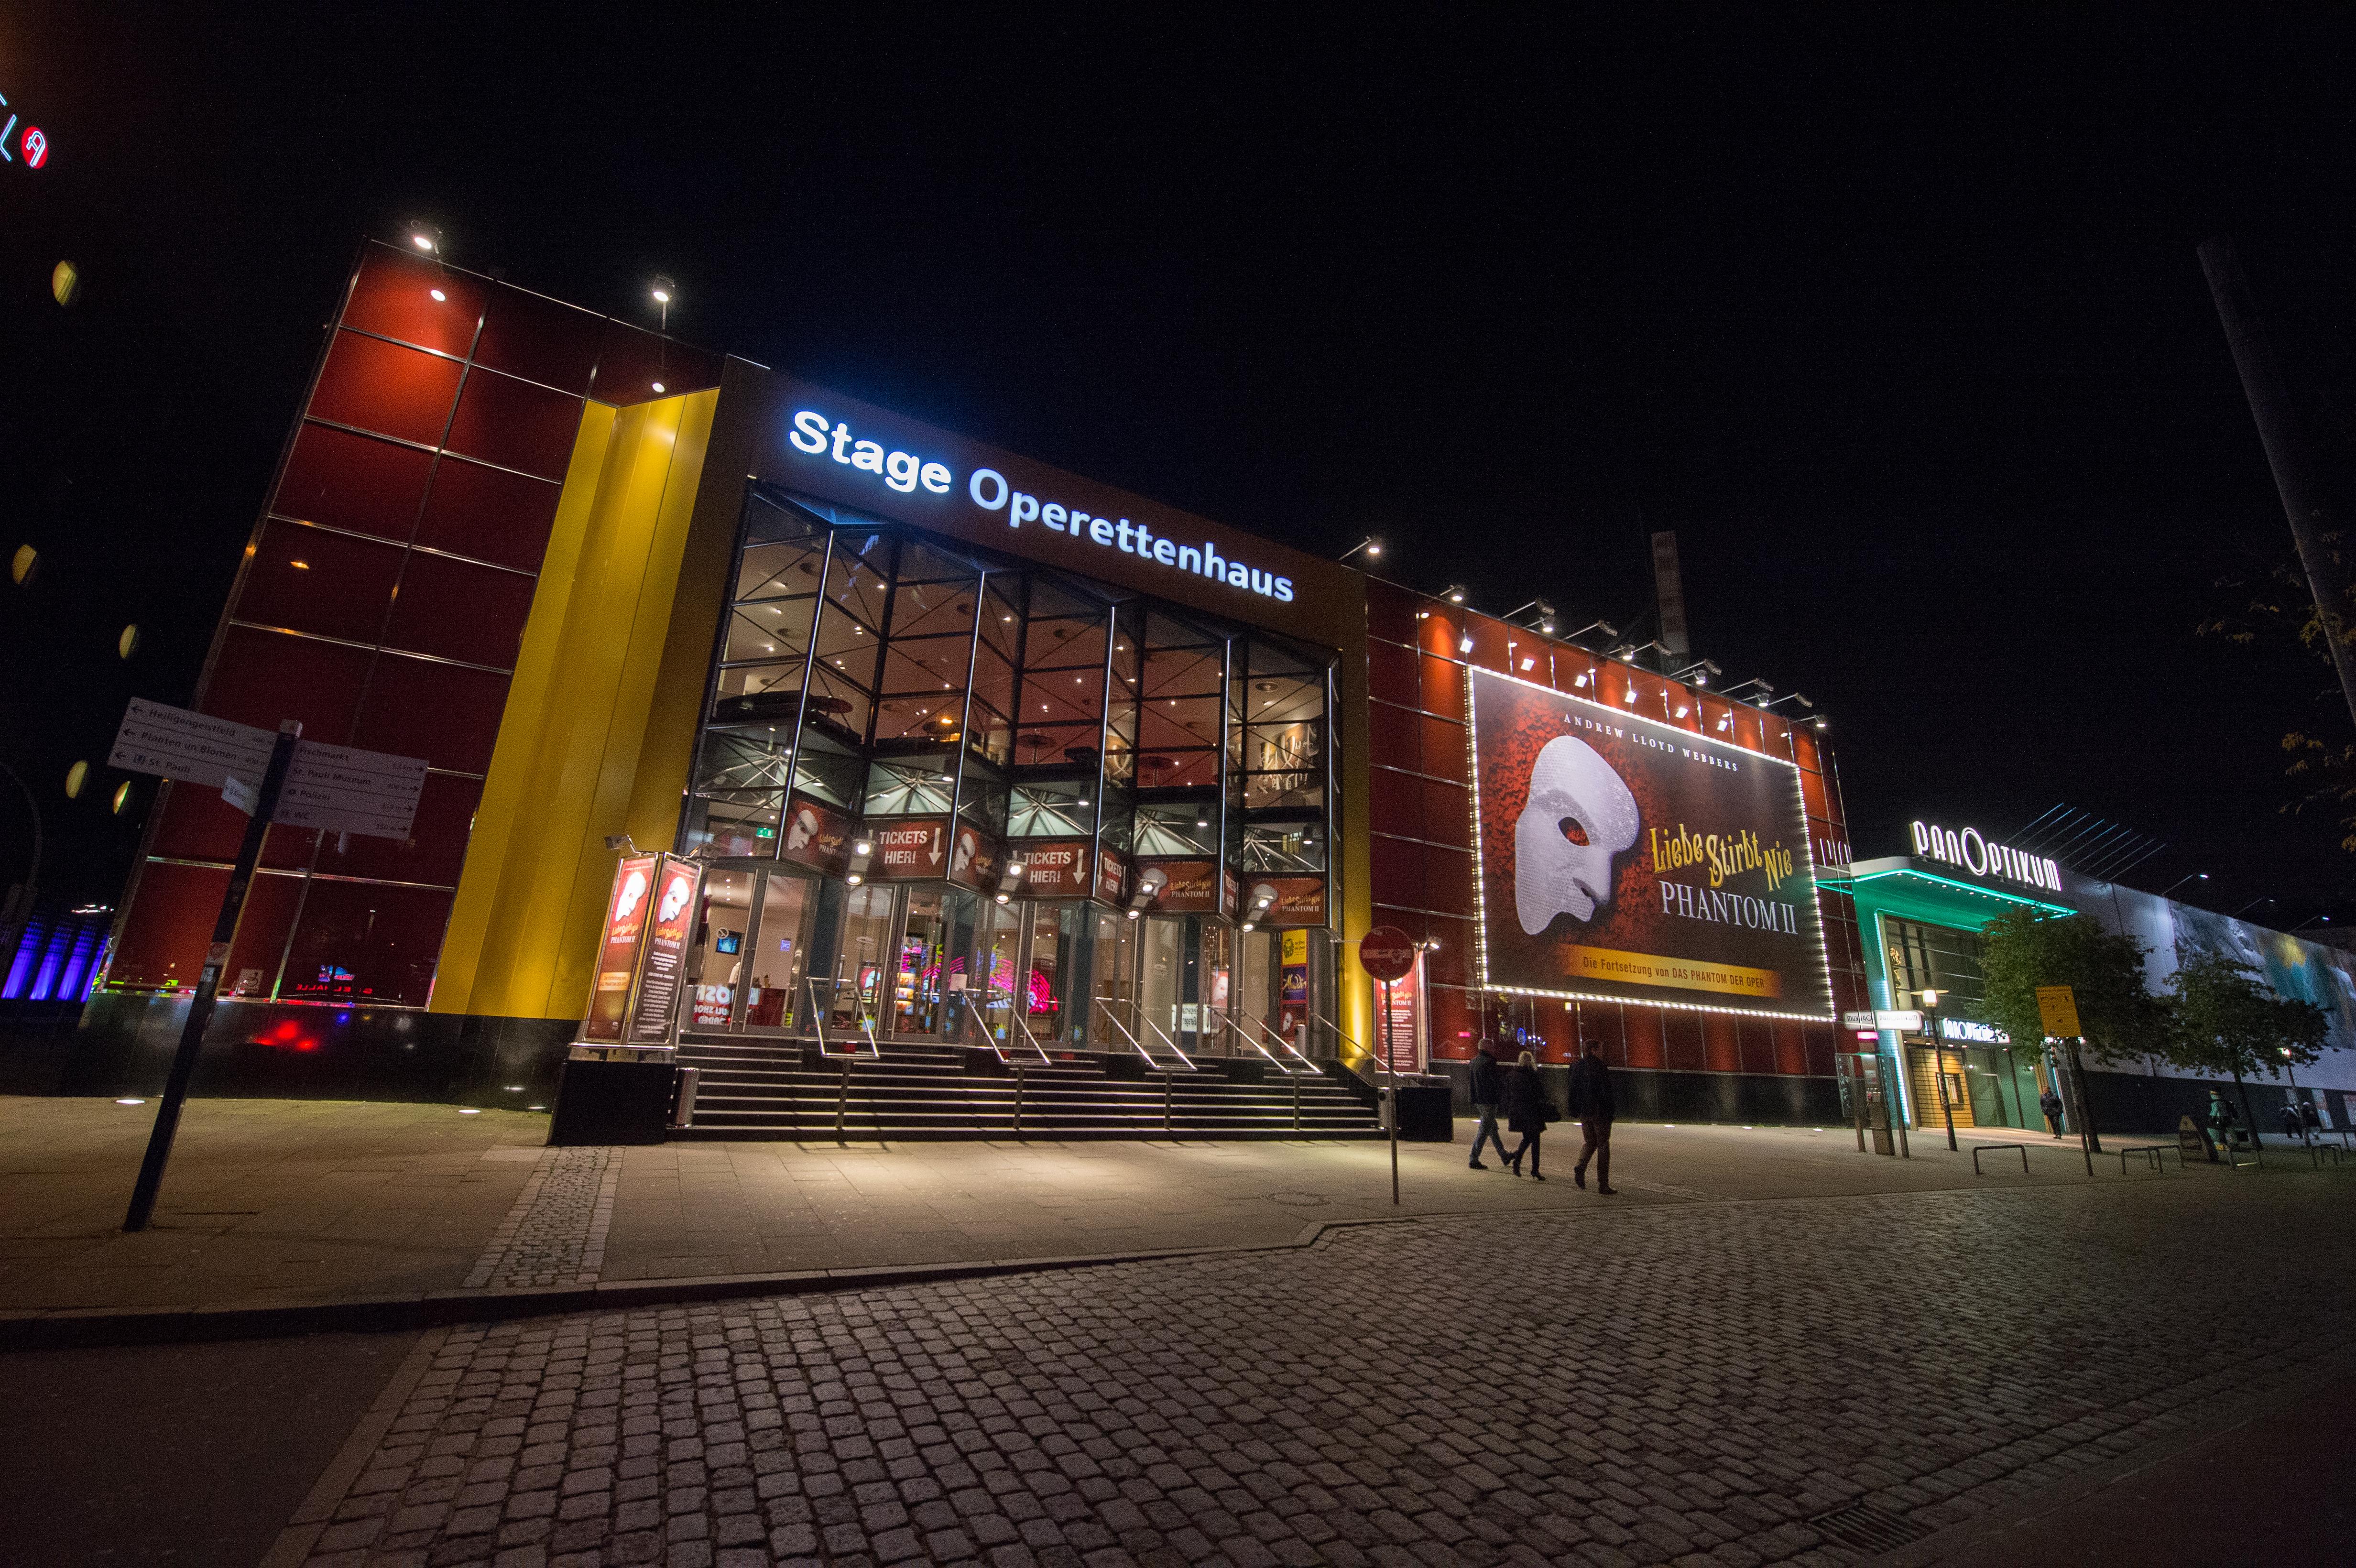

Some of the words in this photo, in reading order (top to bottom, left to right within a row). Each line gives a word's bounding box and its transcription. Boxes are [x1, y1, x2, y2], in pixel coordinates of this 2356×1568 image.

[789, 411, 951, 493] Stage
[969, 468, 1295, 601] Operettenhaus
[149, 709, 236, 737] Heiligengeistfeld
[141, 731, 182, 748] Planten
[184, 742, 197, 751] un
[200, 745, 237, 761] Blomen
[1564, 714, 1624, 738] ANDREW
[1632, 733, 1674, 753] LLOYD
[1682, 748, 1737, 771] WEBBERS
[299, 747, 349, 761] Fischmarkt
[149, 758, 163, 768] St.
[166, 762, 191, 773] Pauli
[293, 767, 304, 776] St.
[307, 770, 330, 780] Pauli
[333, 773, 371, 785] Museum
[300, 789, 331, 801] Polizei
[294, 811, 311, 820] WC
[880, 830, 927, 845] TICKETS
[884, 850, 916, 864] HIER!
[1024, 851, 1071, 865] TICKETS
[1649, 824, 1704, 874] Liebe
[1706, 829, 1763, 888] Stirbt
[1763, 840, 1793, 892] Nie
[1912, 821, 2062, 891] PANOPTIKUM
[1104, 857, 1122, 877] TICKETS
[1030, 871, 1061, 883] HIER!
[1659, 880, 1779, 932] PHANTOM
[1780, 903, 1799, 935] II
[611, 936, 632, 944] PHANTOM
[654, 937, 676, 949] PHANTOM
[1583, 956, 1597, 969] Die
[1601, 958, 1652, 978] Fortsetzung
[1656, 968, 1669, 978] von
[1672, 968, 1688, 980] DAS
[1691, 969, 1727, 984] PHANTOM
[1730, 974, 1744, 987] DER
[1746, 976, 1765, 989] OPER
